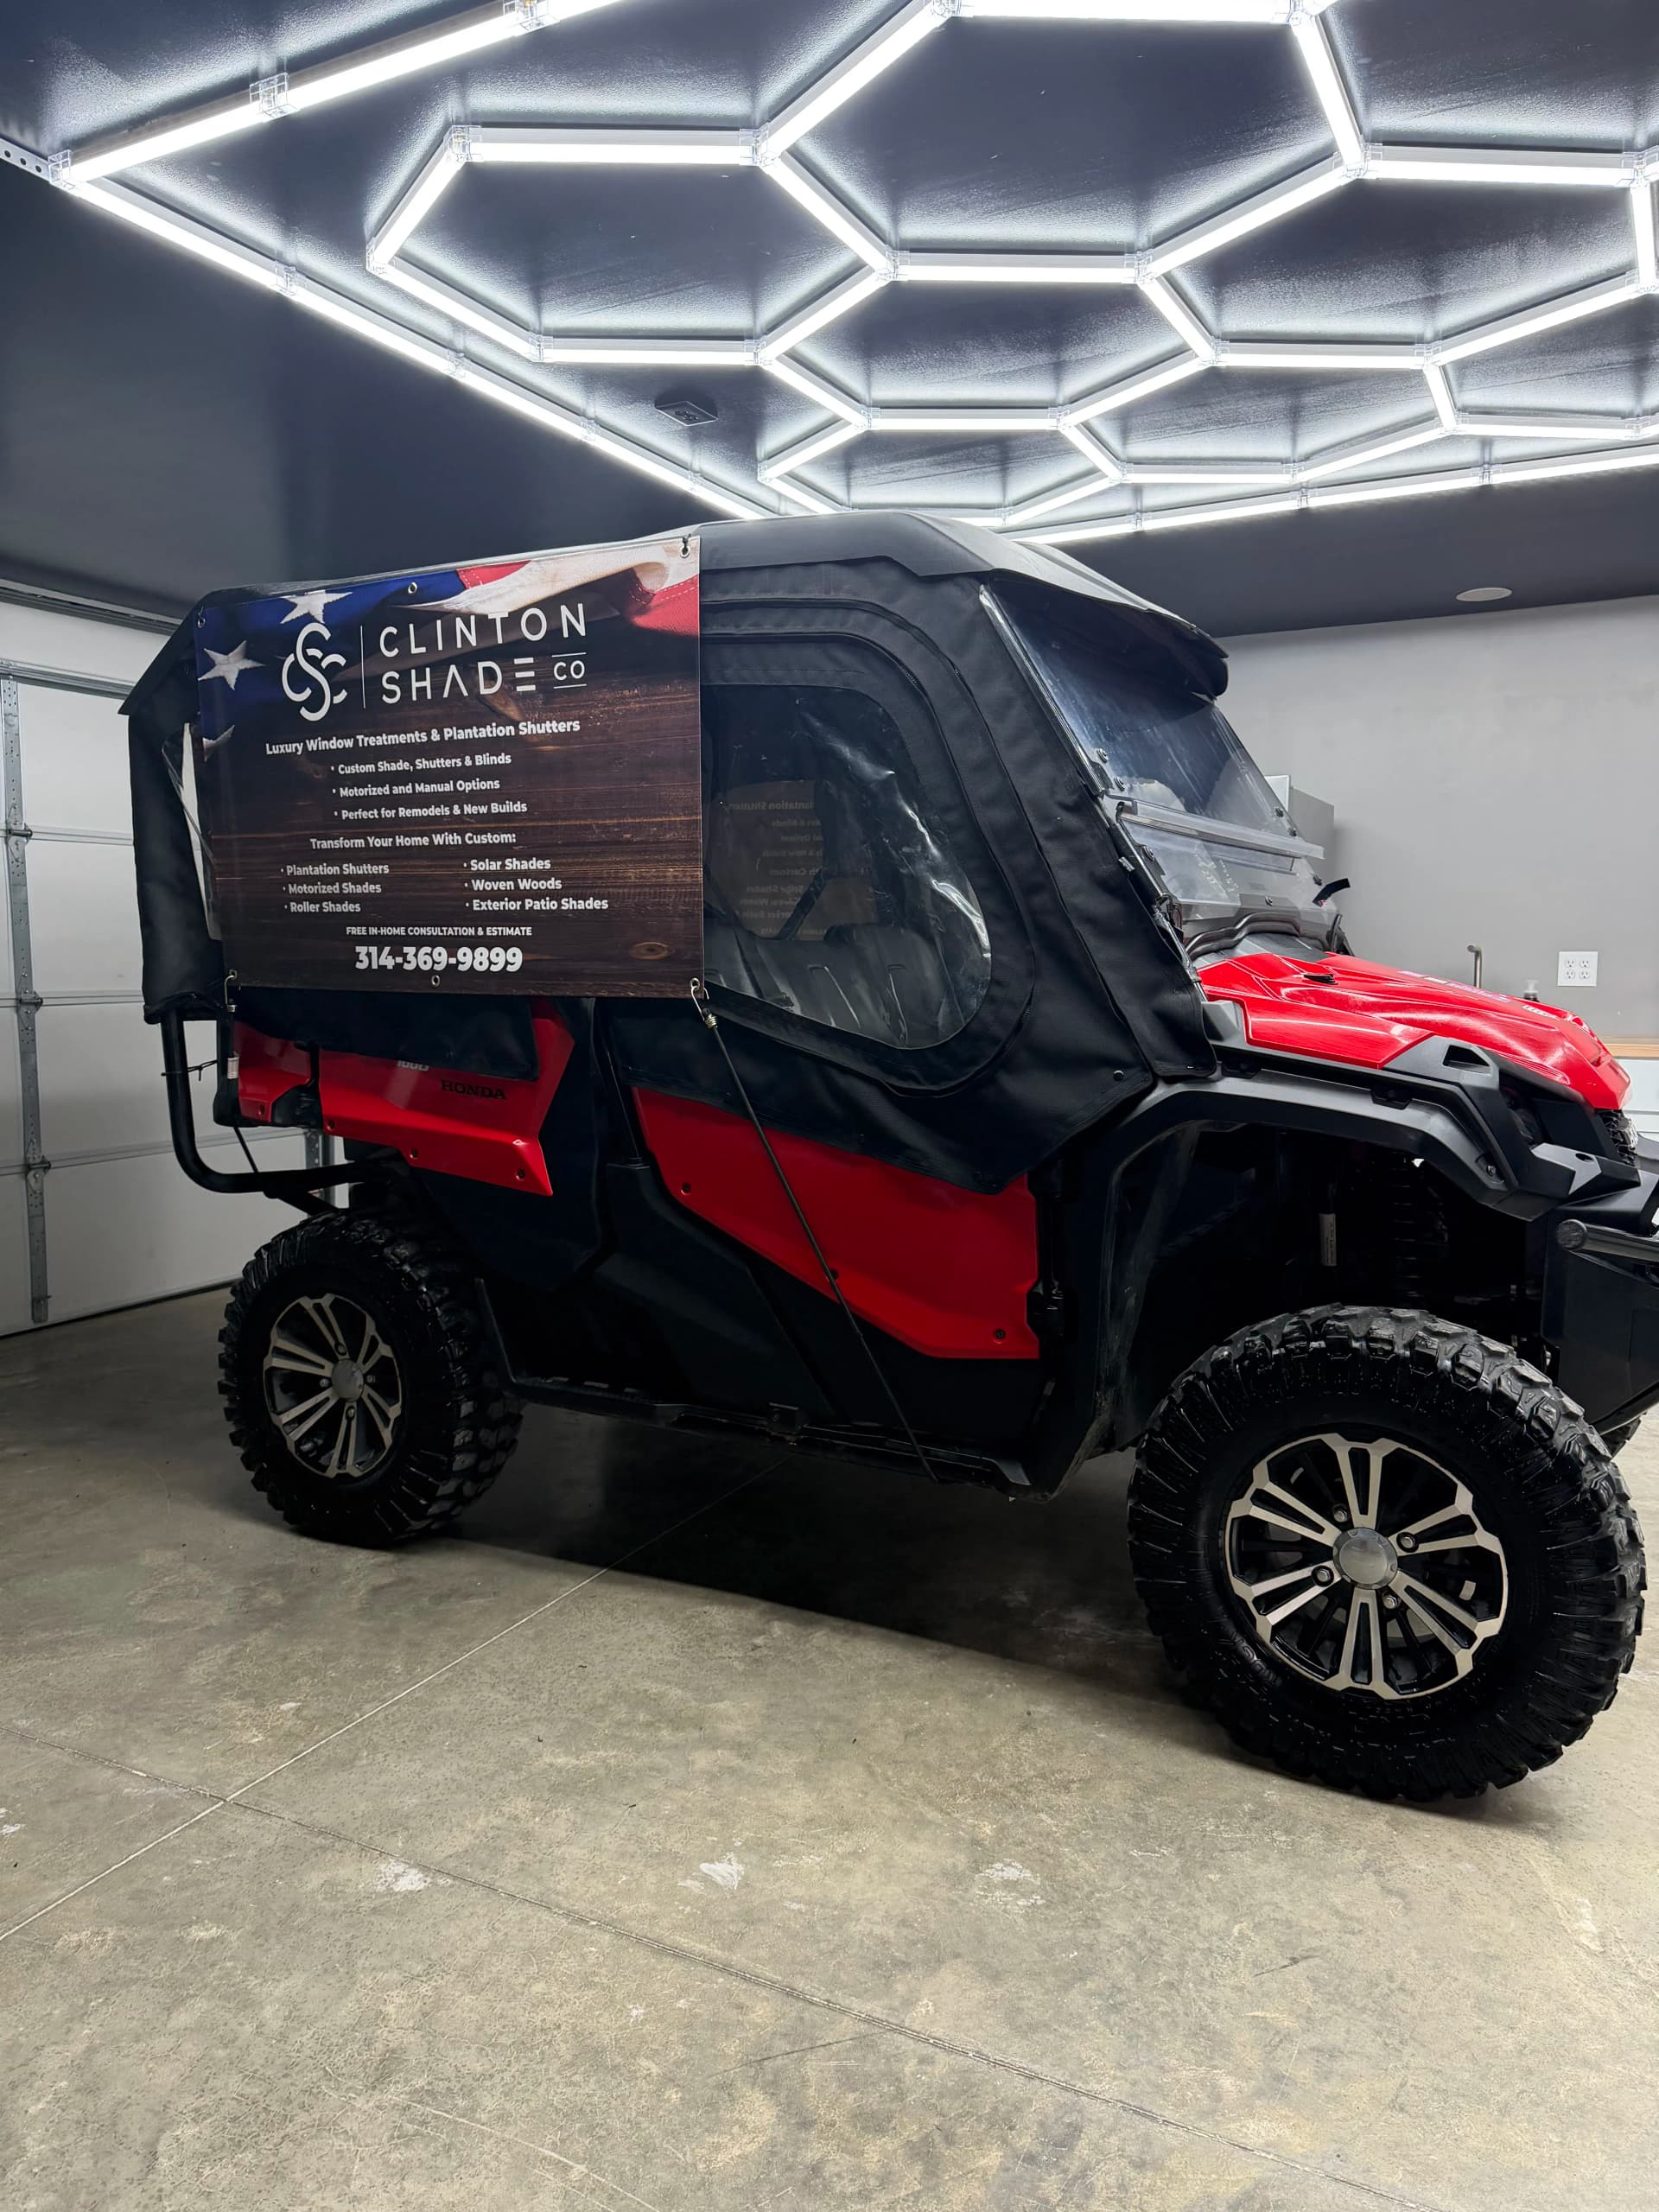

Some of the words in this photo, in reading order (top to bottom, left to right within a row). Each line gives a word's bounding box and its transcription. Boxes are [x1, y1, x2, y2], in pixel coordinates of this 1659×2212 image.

[379, 603, 586, 658] CLINTON
[382, 657, 536, 704] SHADE
[553, 659, 585, 682] CO
[266, 743, 303, 754] Luxury
[306, 737, 353, 751] Window
[356, 731, 427, 747] Treatments
[431, 729, 440, 741] &
[444, 722, 515, 740] Plantation
[519, 721, 580, 734] Shutters
[339, 764, 375, 774] Custom
[378, 760, 413, 772] Shade,
[416, 758, 461, 769] Shutters
[465, 756, 472, 766] &
[475, 753, 512, 765] Blinds
[340, 785, 390, 797] Motorized
[392, 783, 412, 794] and
[415, 780, 454, 792] Manual
[456, 779, 499, 792] Options
[342, 809, 378, 819] Perfect
[381, 808, 396, 817] for
[398, 805, 449, 817] Remodels
[453, 804, 461, 815] &
[464, 804, 487, 814] New
[491, 801, 527, 813] Builds
[310, 837, 365, 849] Transform
[367, 836, 392, 847] Your
[396, 836, 429, 846] Home
[432, 832, 461, 845] With
[465, 833, 516, 844] Custom:
[287, 863, 340, 875] Plantation
[343, 863, 389, 874] Shutters
[471, 859, 501, 870] Solar
[505, 857, 550, 870] Shades
[289, 882, 340, 893] Motorized
[342, 882, 381, 893] Shades
[472, 880, 514, 890] Woven
[518, 878, 562, 889] Woods
[290, 901, 320, 912] Roller
[322, 901, 360, 912] Shades
[473, 898, 521, 910] Exterior
[525, 897, 557, 910] Patio
[562, 897, 608, 909] Shades
[356, 946, 522, 971] 314-369-9899
[442, 1080, 506, 1099] HONDA
